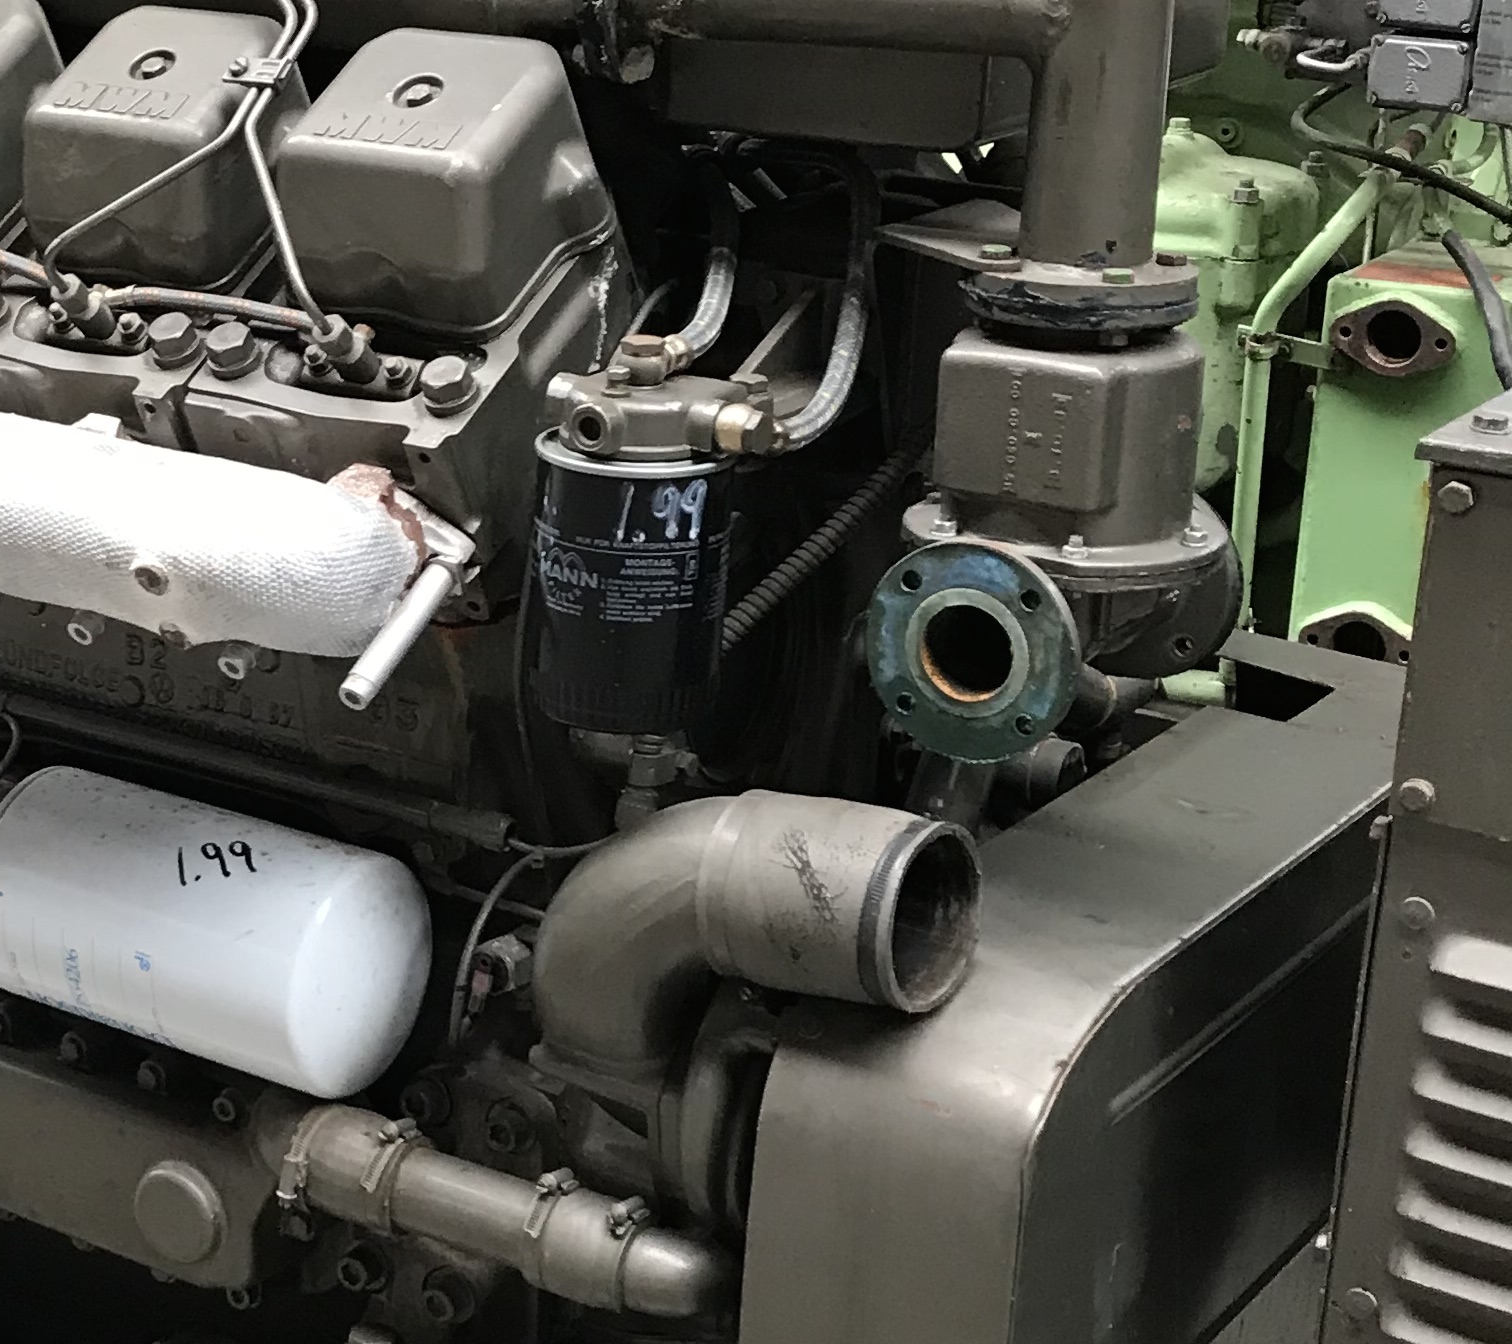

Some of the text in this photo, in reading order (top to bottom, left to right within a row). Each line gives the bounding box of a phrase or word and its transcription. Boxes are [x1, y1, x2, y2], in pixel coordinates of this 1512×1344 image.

[53, 81, 191, 120] MWM
[312, 112, 464, 151] MWM
[616, 479, 708, 543] 1.99
[540, 556, 598, 589] MANN
[125, 631, 168, 670] B2
[177, 840, 258, 887] 1.99
